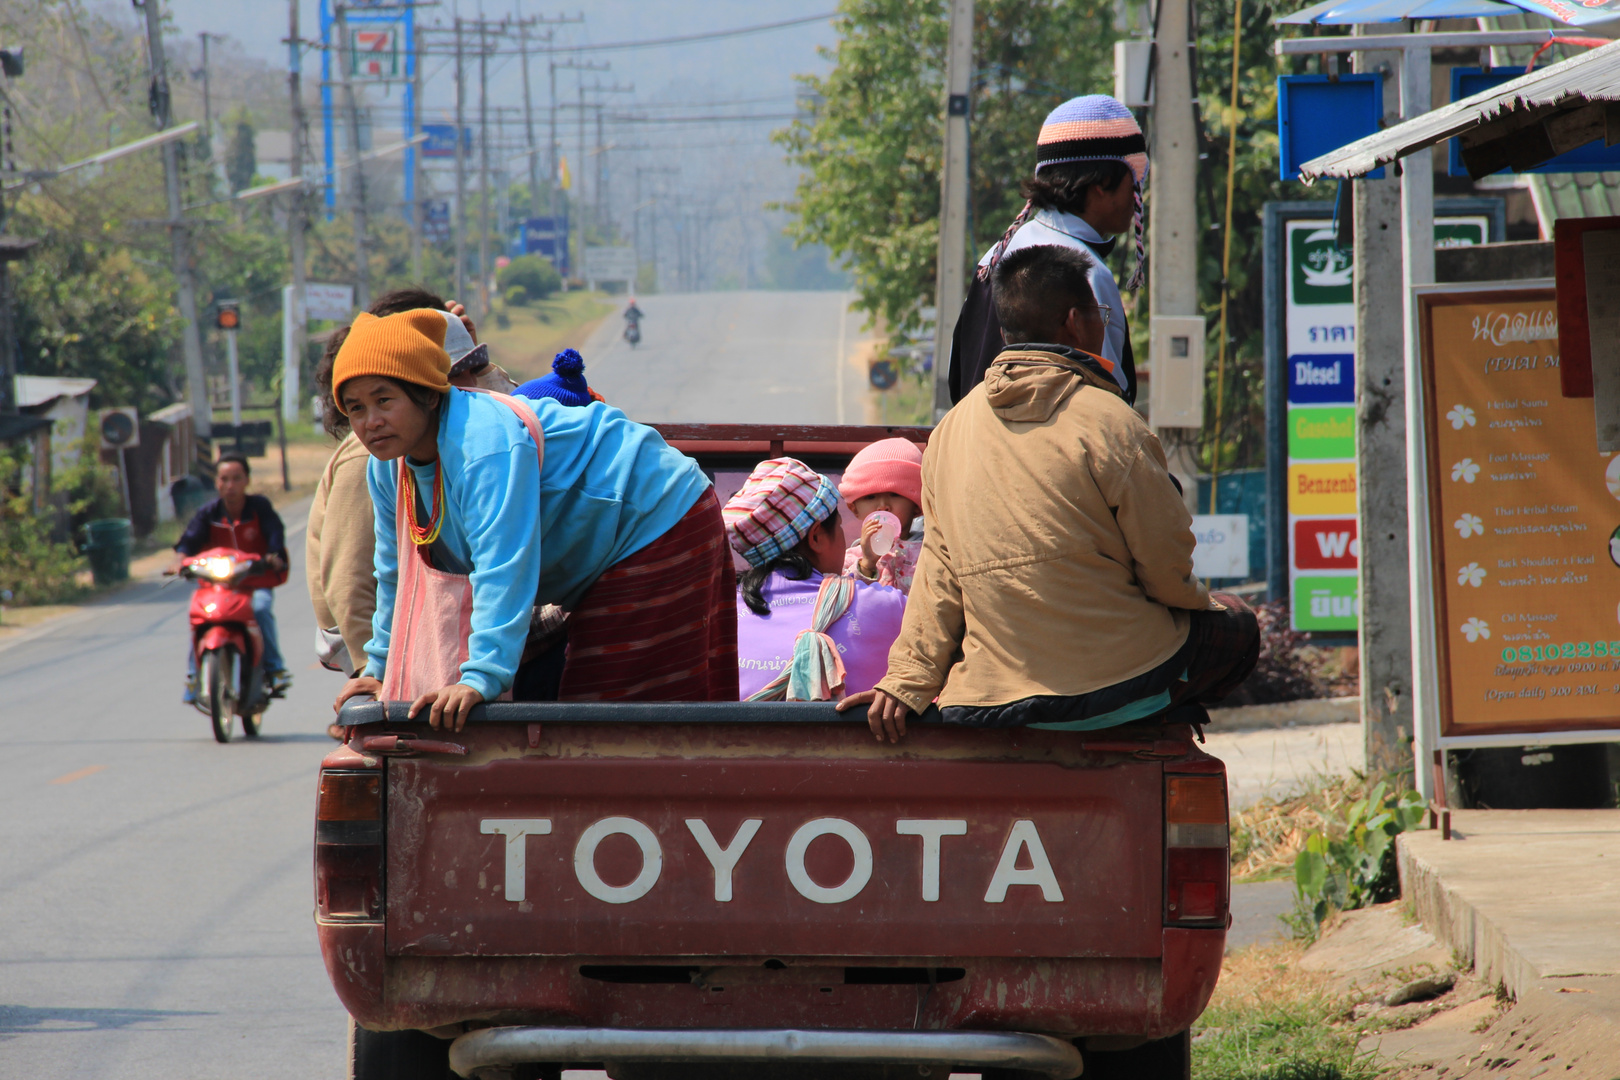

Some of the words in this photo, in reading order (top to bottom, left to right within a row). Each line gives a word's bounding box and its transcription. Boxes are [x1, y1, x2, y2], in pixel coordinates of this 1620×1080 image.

[1295, 361, 1341, 385] Diesel
[1487, 398, 1518, 410] Herbal
[1521, 399, 1548, 409] Sauna
[1296, 416, 1353, 439] Gasohol
[1488, 453, 1507, 463] Foot
[1511, 452, 1550, 463] Massage
[1494, 506, 1514, 516] Thai
[1516, 504, 1548, 515] Herbal
[1550, 503, 1578, 514] Steam
[1498, 558, 1518, 568] Back
[1521, 556, 1559, 567] Shoulder
[1570, 554, 1595, 565] Head
[1501, 613, 1516, 623] Oil
[1519, 613, 1558, 623] Massage
[1567, 662, 1596, 673] 09.00
[1484, 688, 1516, 702] (Open
[1518, 686, 1546, 700] daily
[1549, 686, 1571, 697] 9.00
[480, 815, 1064, 904] TOYOTA
